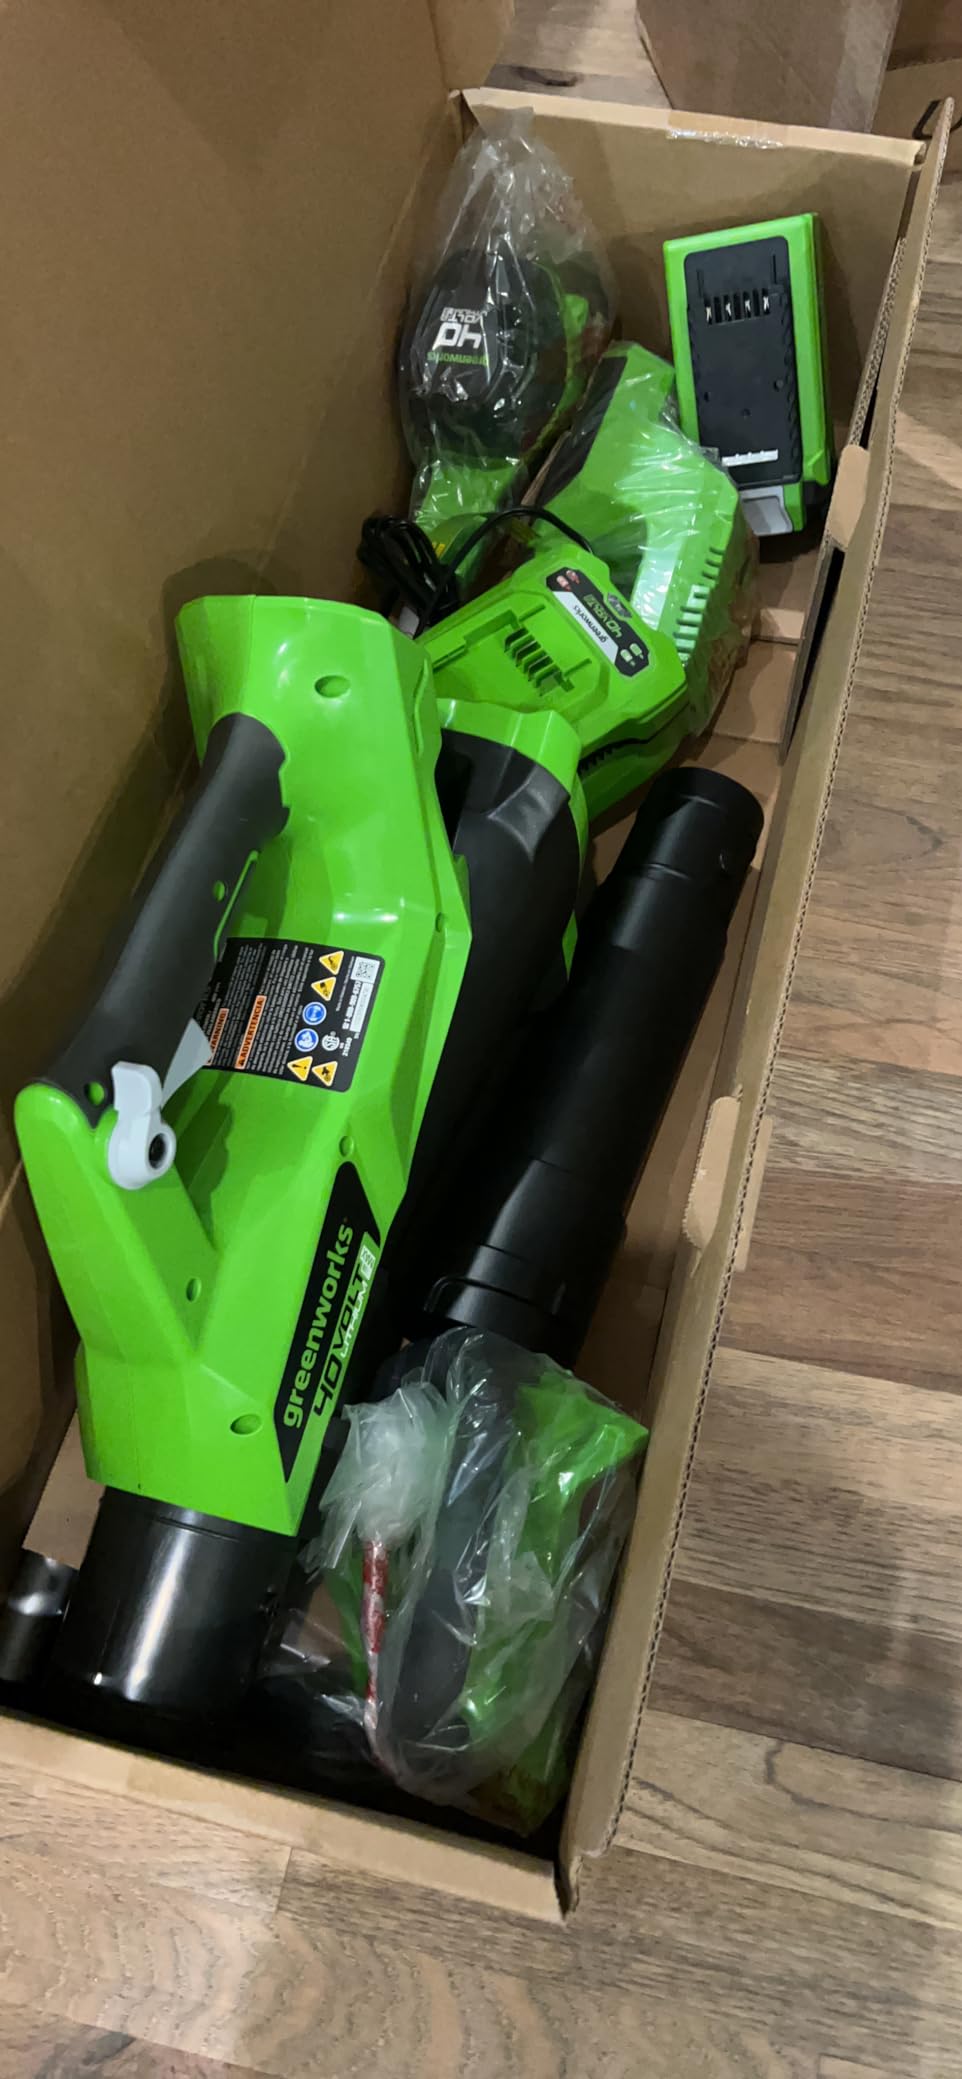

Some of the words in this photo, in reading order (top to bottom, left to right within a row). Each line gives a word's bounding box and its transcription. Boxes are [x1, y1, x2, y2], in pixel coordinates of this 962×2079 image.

[436, 322, 482, 349] 40
[573, 605, 608, 643] greenworks
[606, 620, 622, 638] 40
[283, 1224, 353, 1429] greenworks
[313, 1353, 342, 1416] 40
[333, 1264, 364, 1349] VOLT
[340, 1279, 368, 1358] LITHIUM
